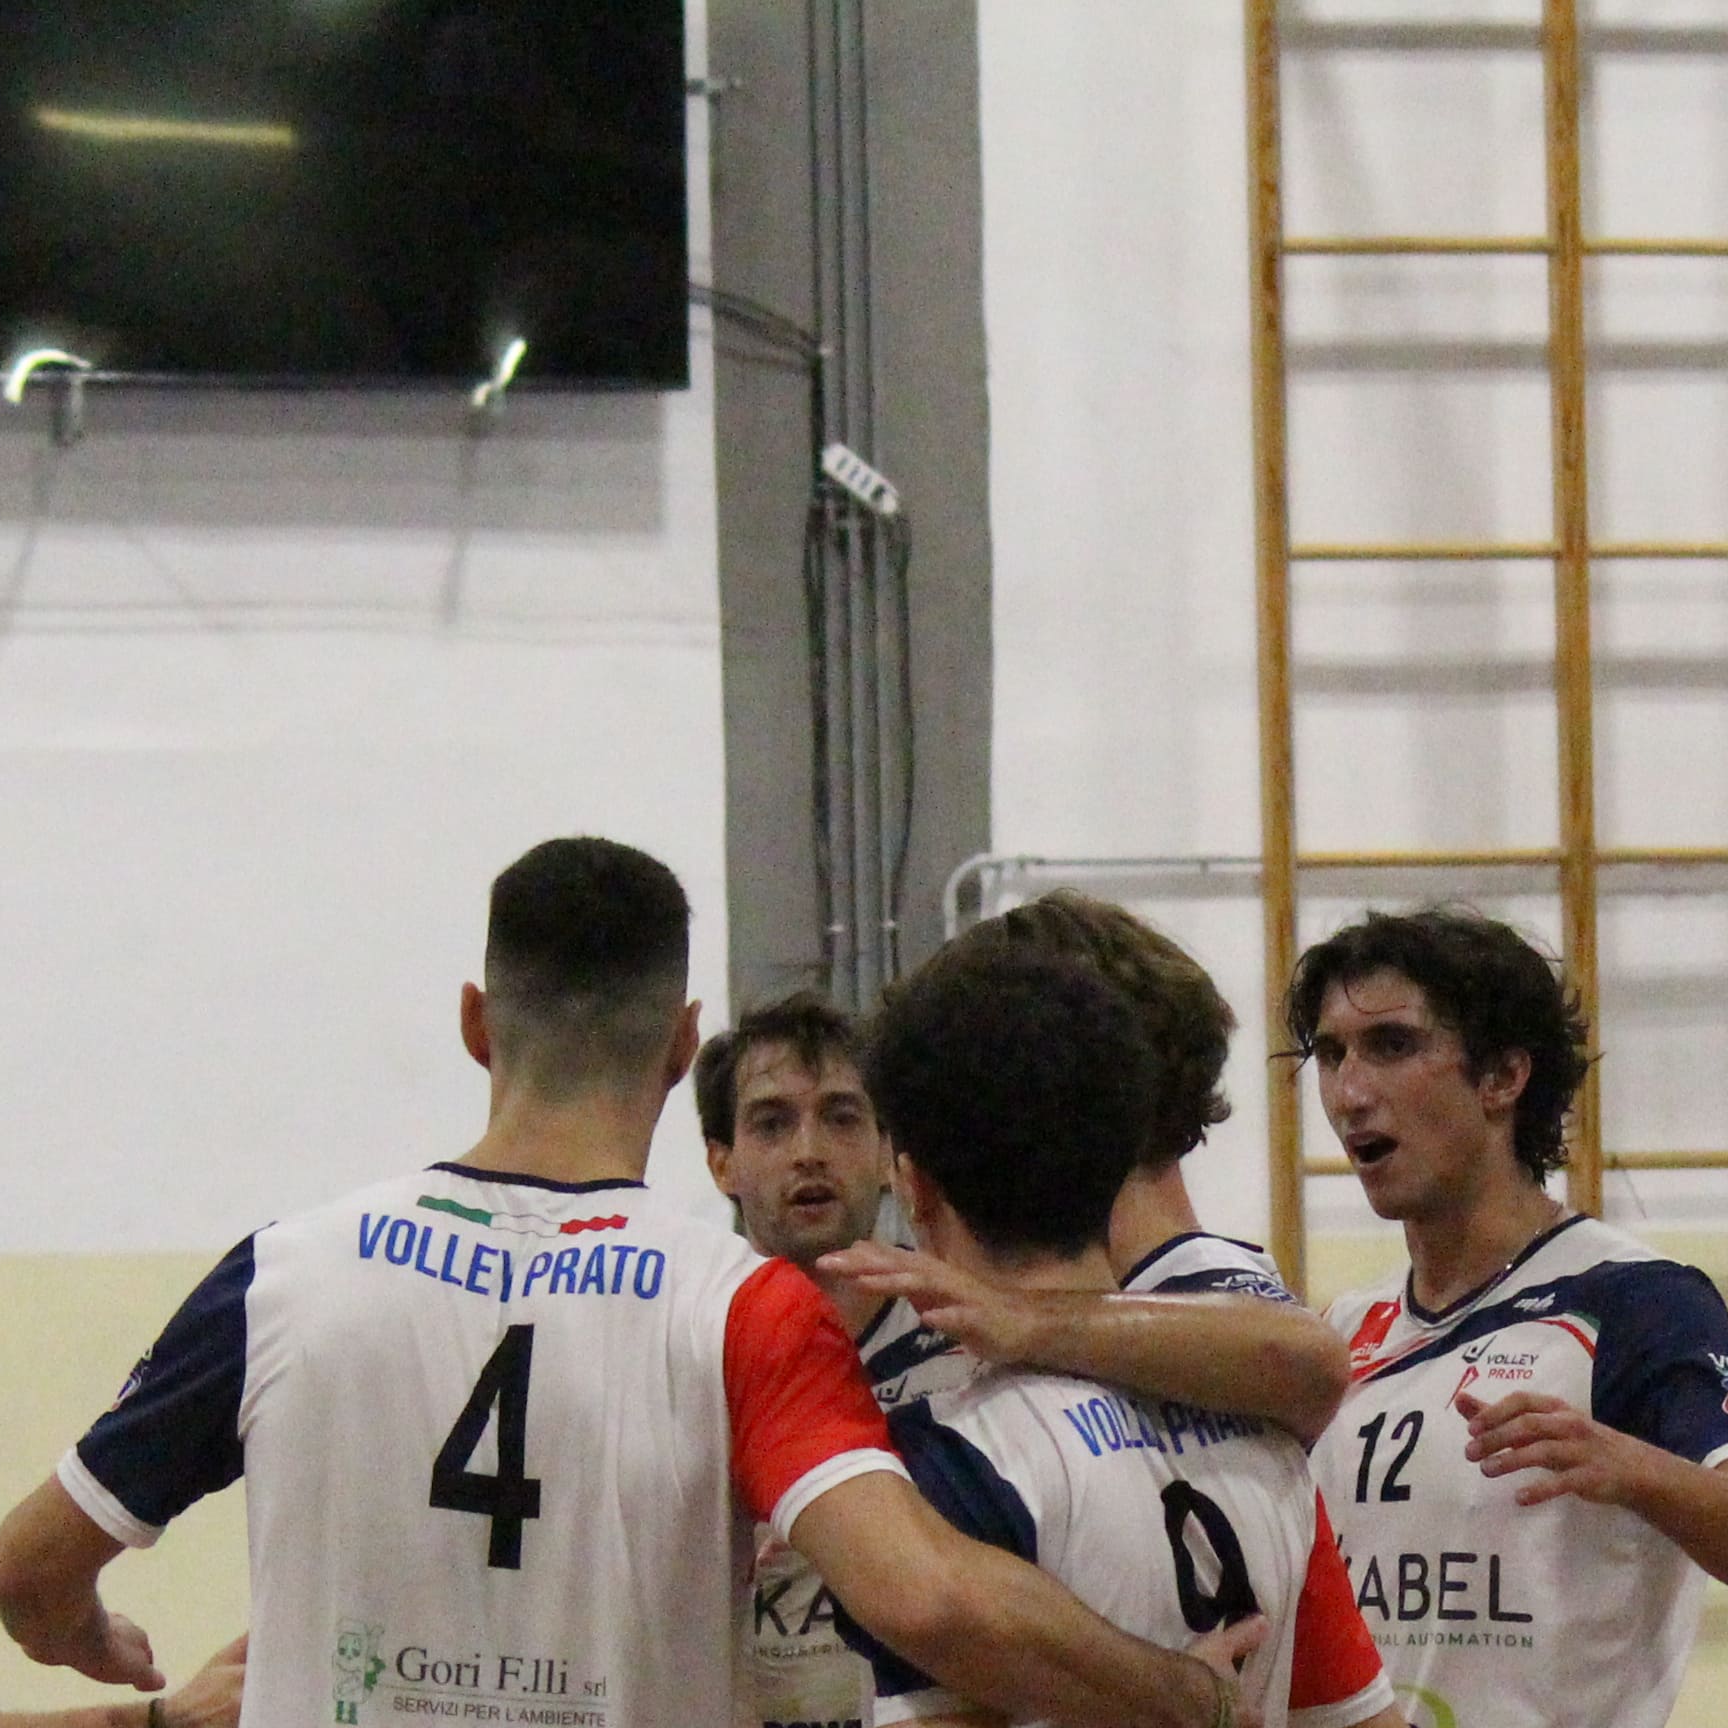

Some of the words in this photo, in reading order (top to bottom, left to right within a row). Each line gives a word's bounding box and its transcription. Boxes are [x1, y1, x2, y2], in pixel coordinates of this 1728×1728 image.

[359, 1213, 513, 1303] VOLLEY
[522, 1243, 666, 1299] PRATO
[1486, 1353, 1540, 1366] VOLLEY
[1487, 1368, 1534, 1380] PRATO
[429, 1323, 541, 1569] 4
[1355, 1410, 1424, 1503] 12
[1344, 1550, 1533, 1623] ABEL
[395, 1646, 481, 1689] Gori
[496, 1655, 568, 1695] F.lli
[583, 1676, 607, 1697] srl
[392, 1696, 459, 1717] SERVIZI
[463, 1704, 501, 1721] PER
